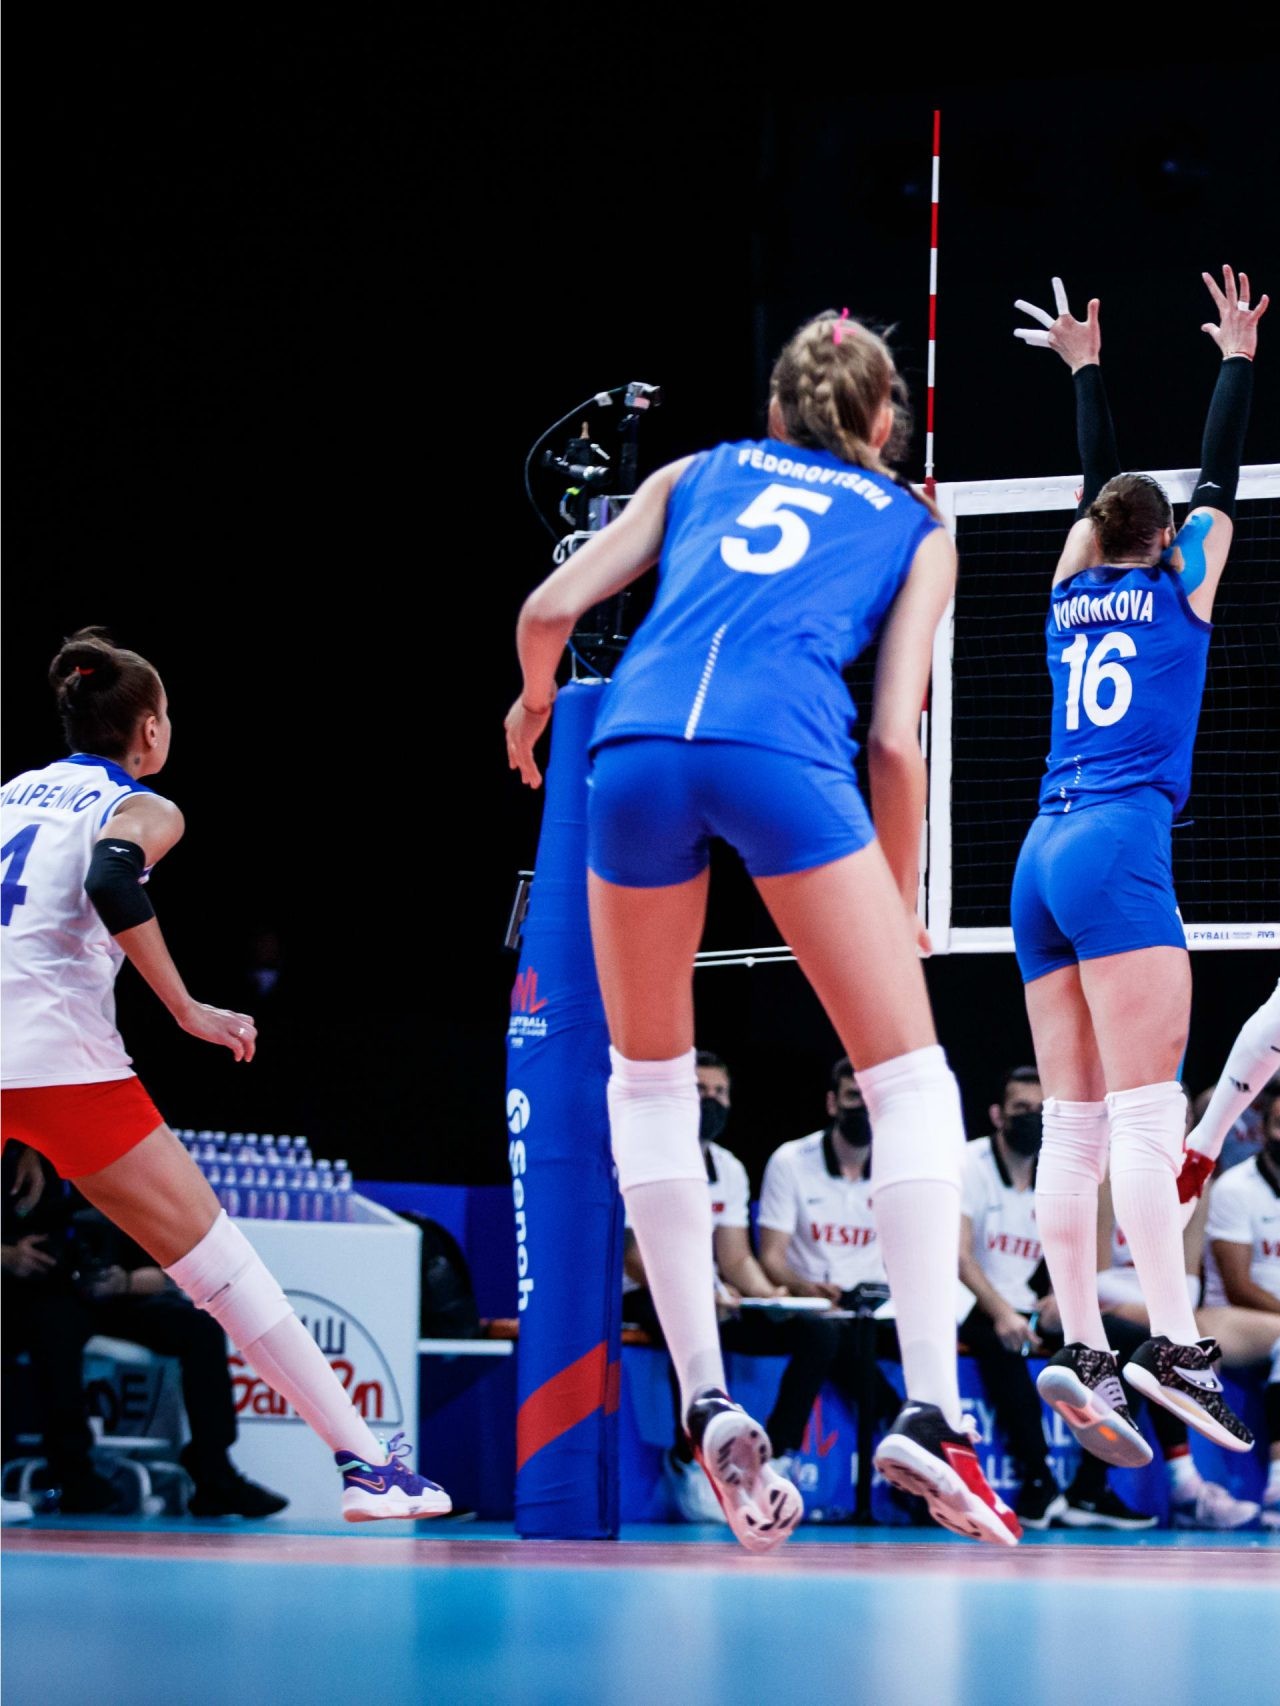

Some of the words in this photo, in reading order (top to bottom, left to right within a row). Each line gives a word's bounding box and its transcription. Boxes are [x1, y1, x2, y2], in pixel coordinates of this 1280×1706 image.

[738, 449, 893, 511] FEDOROVTSEVA
[720, 483, 832, 575] 5
[1053, 590, 1153, 631] VORONKOVA
[1061, 631, 1137, 730] 16
[1, 784, 101, 812] ILIPENKO
[1187, 931, 1230, 940] LEYBALL
